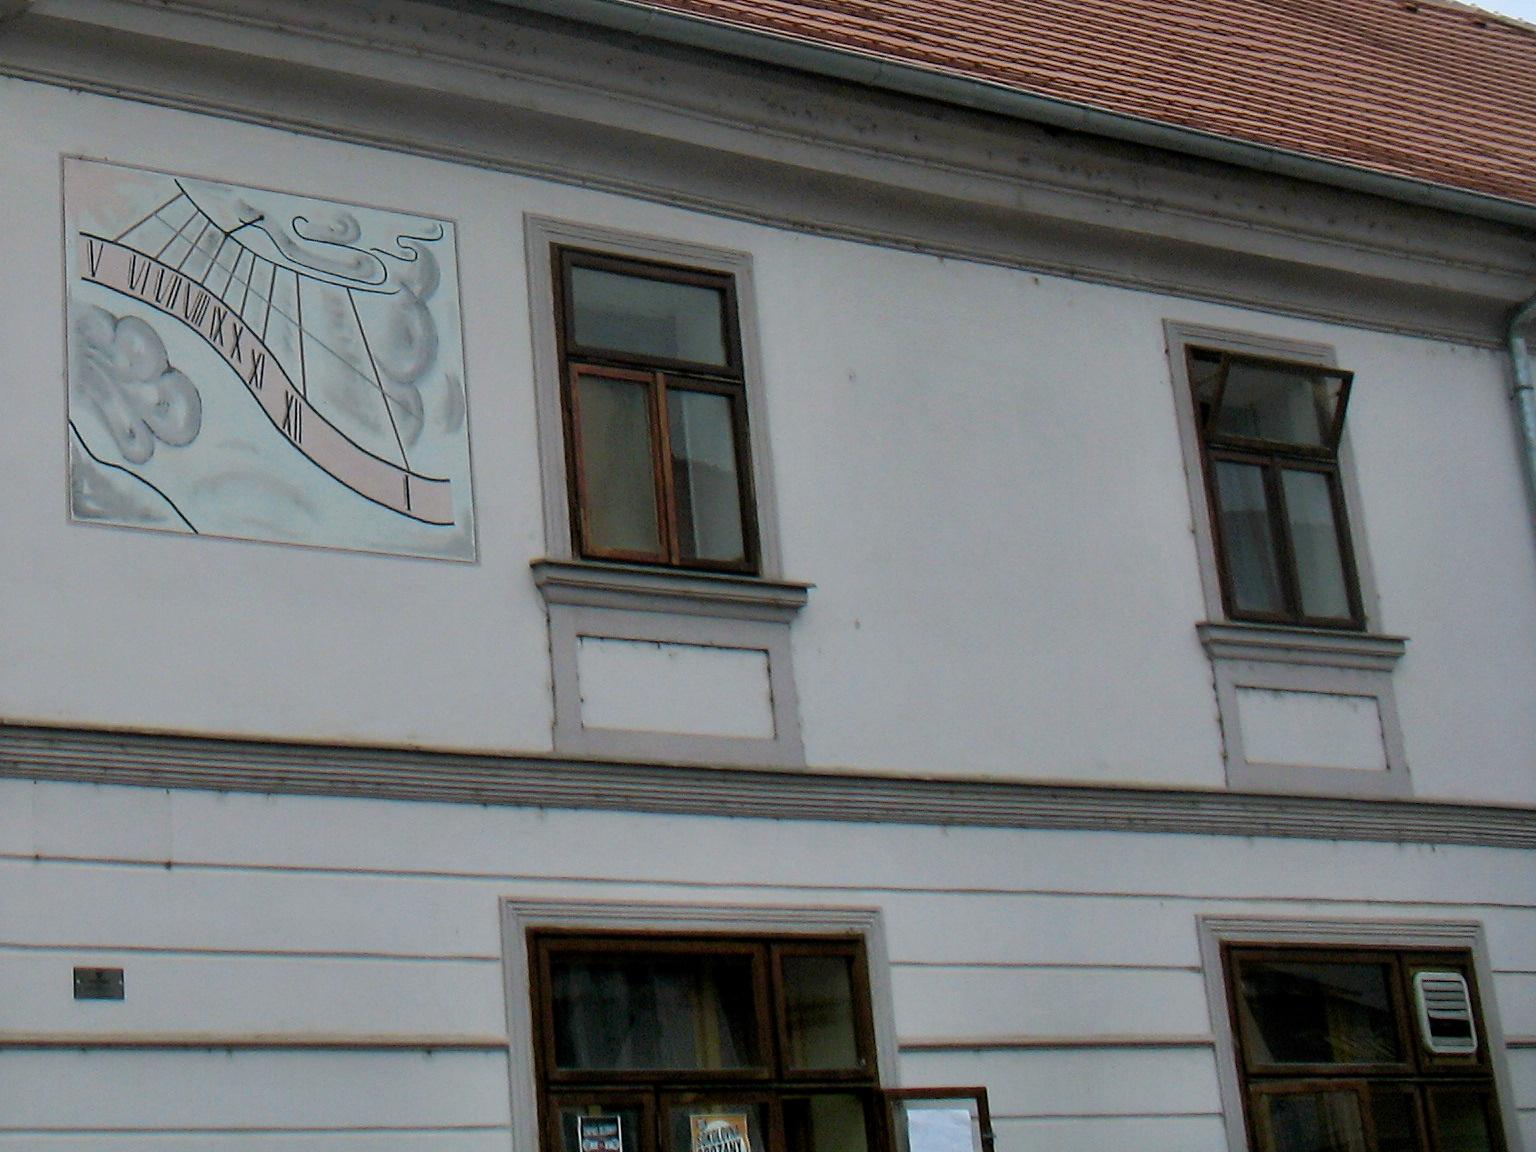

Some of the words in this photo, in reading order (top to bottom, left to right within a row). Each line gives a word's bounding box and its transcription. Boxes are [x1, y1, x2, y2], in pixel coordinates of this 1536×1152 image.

[87, 240, 104, 278] V
[128, 254, 151, 295] VI
[154, 268, 183, 310] VII
[182, 282, 211, 327] VIII
[209, 306, 228, 347] IX
[230, 323, 244, 364] X
[248, 349, 265, 390] XI
[282, 390, 302, 445] XII
